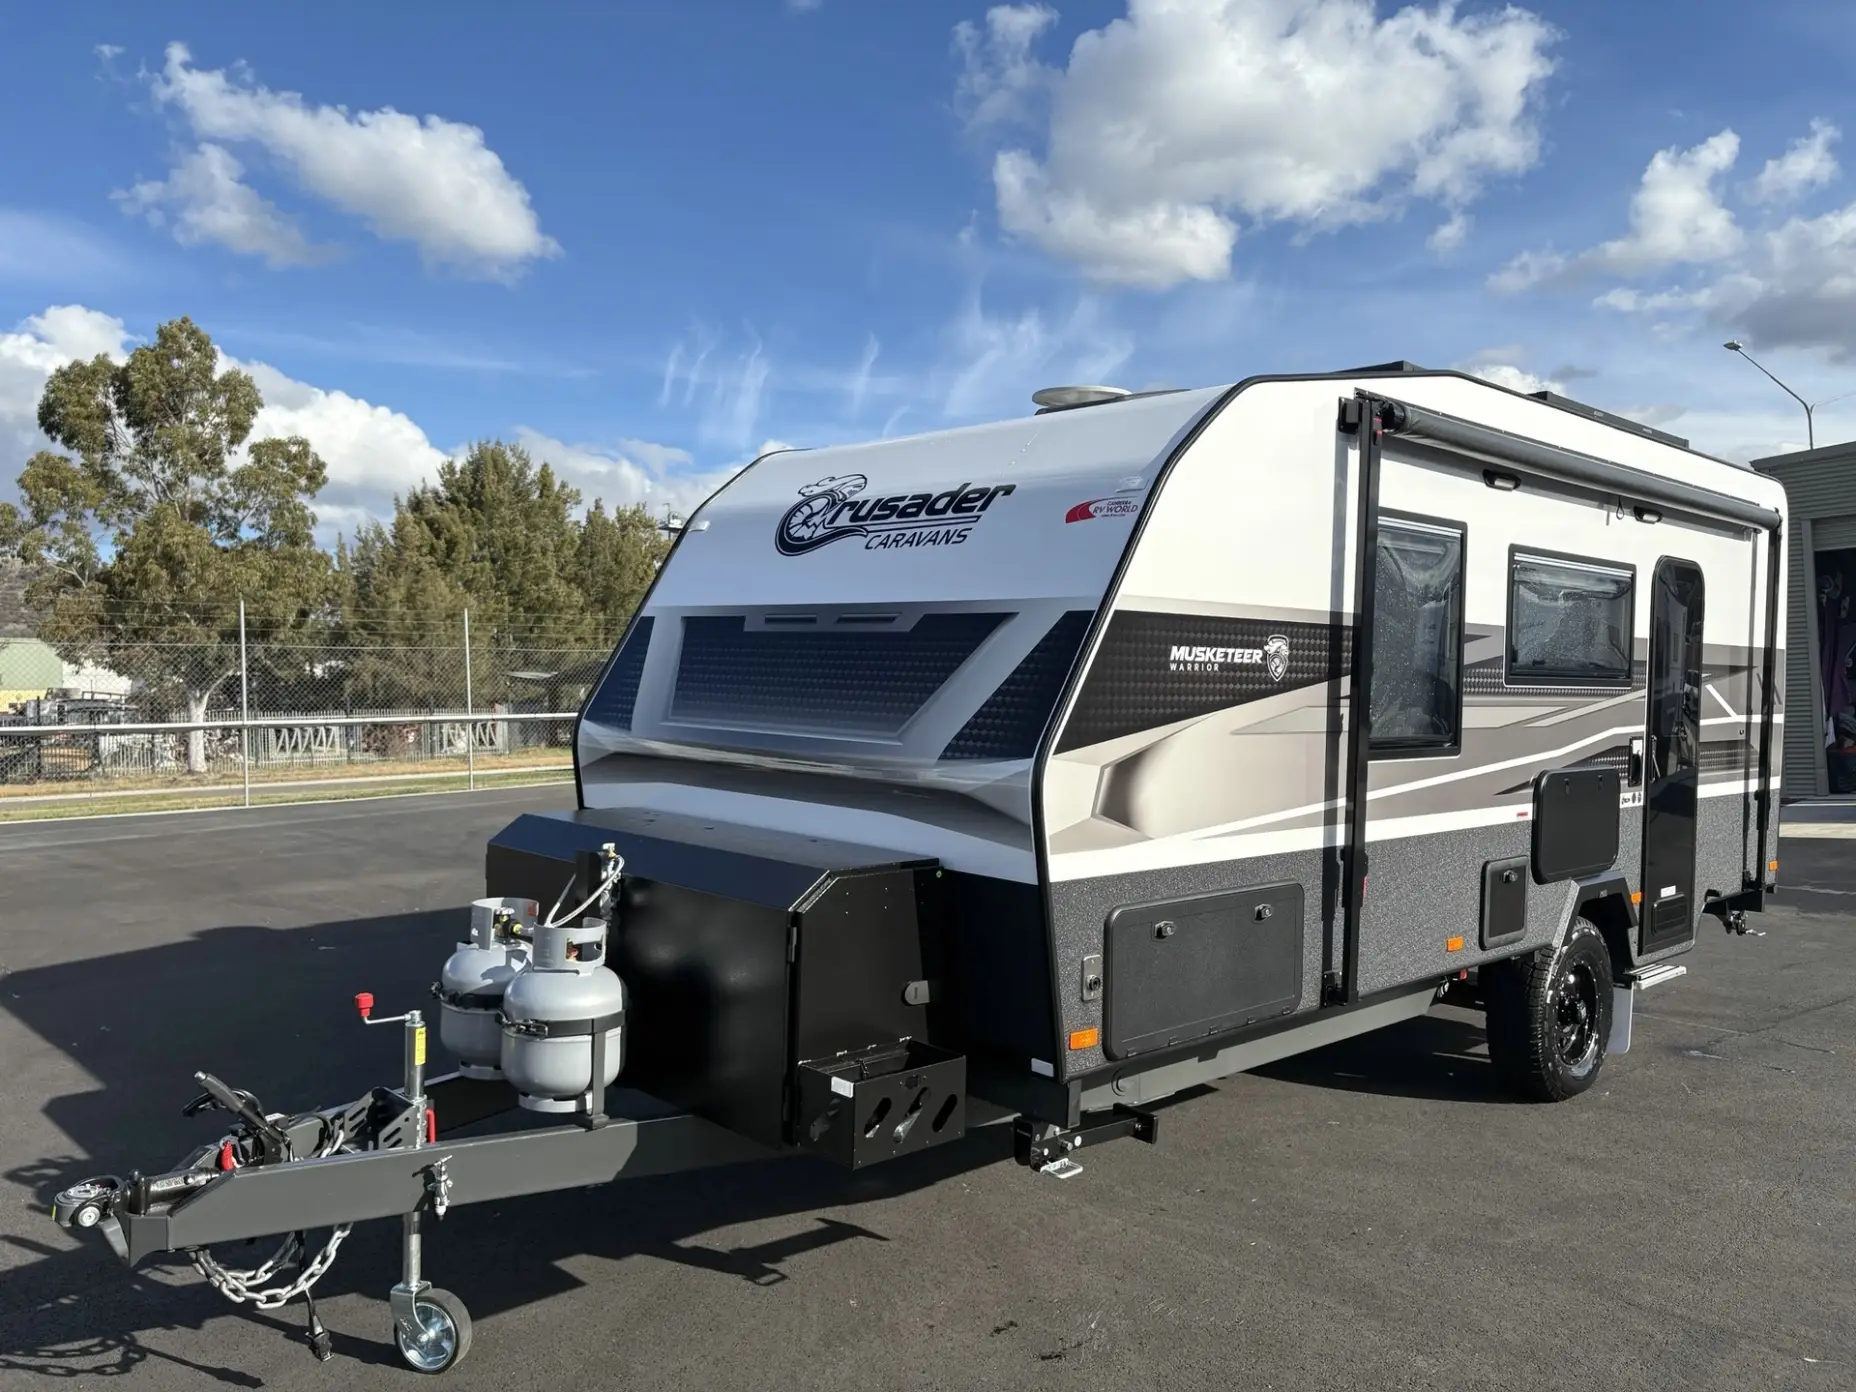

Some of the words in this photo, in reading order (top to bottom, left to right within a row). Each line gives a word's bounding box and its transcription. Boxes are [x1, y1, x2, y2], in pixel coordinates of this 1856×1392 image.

[1093, 506, 1105, 514] RV
[1106, 505, 1139, 513] WORLD
[865, 527, 973, 550] CARAVANS
[1170, 645, 1264, 663] MUSKETEER
[1169, 662, 1220, 672] WARRIOR
